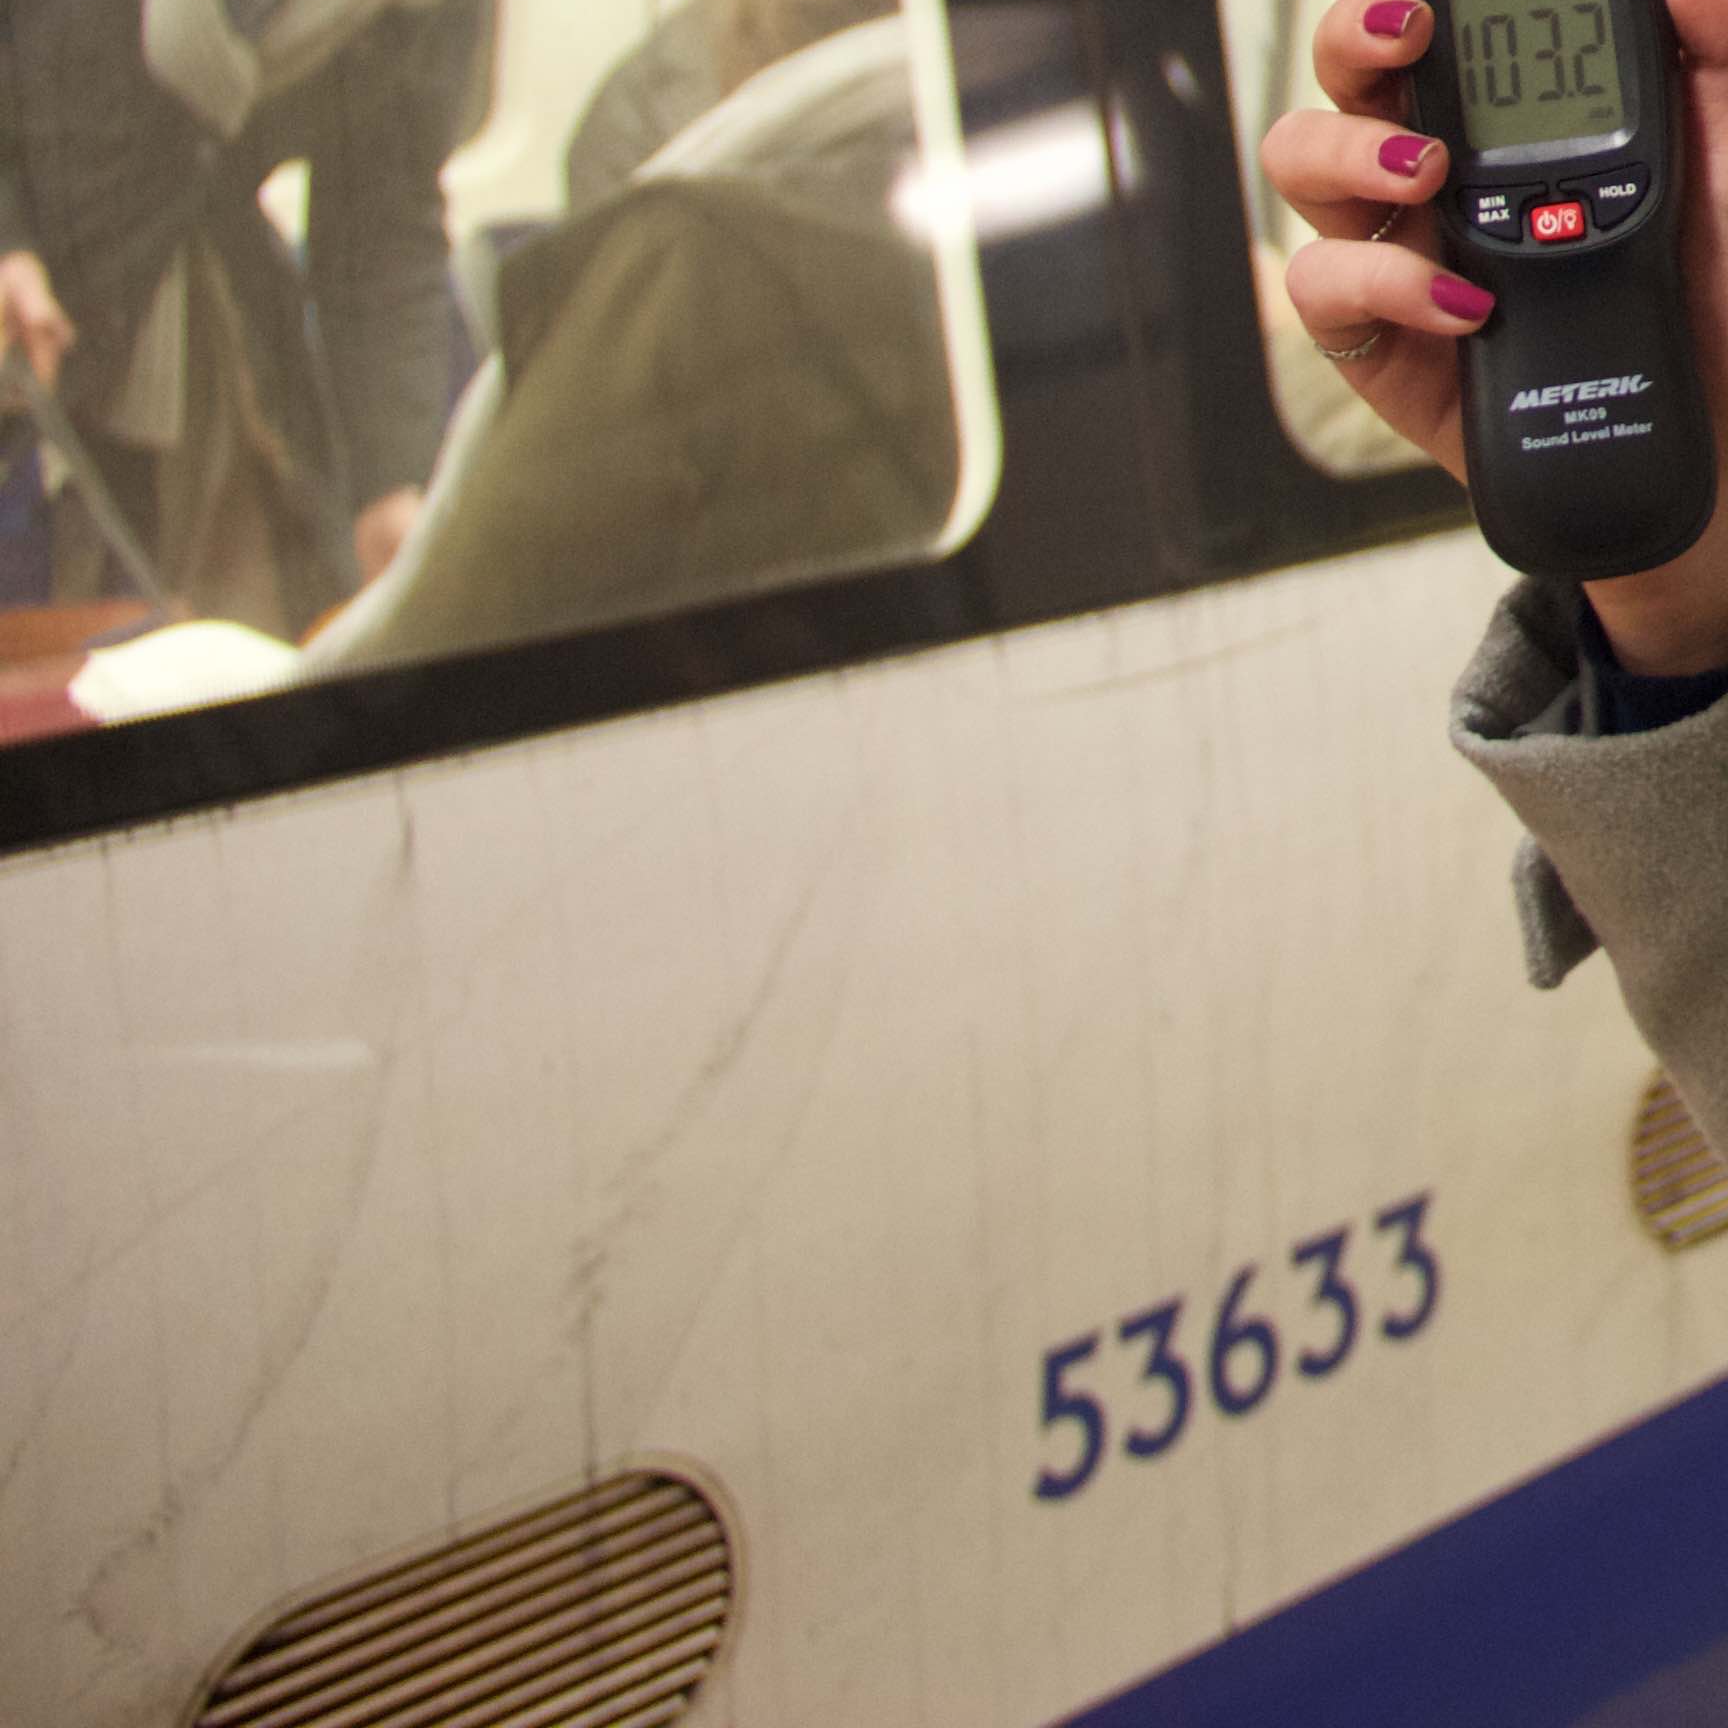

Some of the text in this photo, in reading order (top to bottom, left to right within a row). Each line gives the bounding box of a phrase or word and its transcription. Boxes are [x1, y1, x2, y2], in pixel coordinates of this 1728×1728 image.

[1462, 2, 1606, 108] 103.2
[1479, 195, 1506, 210] MIN
[1599, 183, 1637, 199] HOLD
[1478, 208, 1511, 224] MAX
[1510, 373, 1654, 411] METERK
[1564, 407, 1608, 425] MK09
[1521, 421, 1654, 451] Sound Level Meter
[1033, 1188, 1440, 1503] 53633
